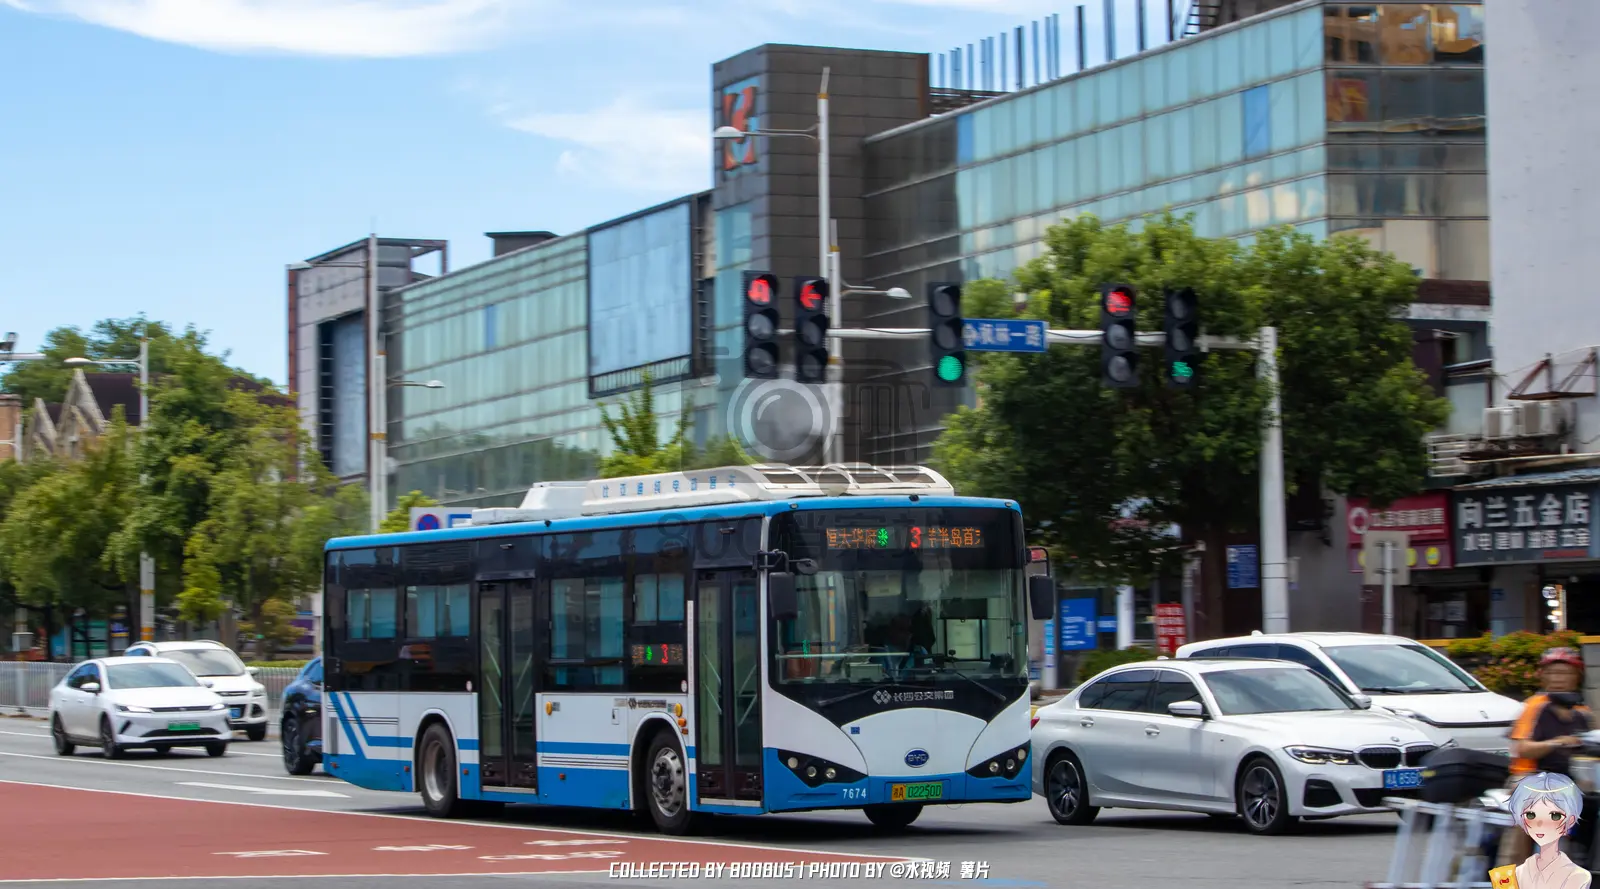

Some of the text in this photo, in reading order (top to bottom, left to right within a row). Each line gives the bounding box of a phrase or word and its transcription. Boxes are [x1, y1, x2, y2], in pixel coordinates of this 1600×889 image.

[910, 527, 922, 548] 3
[893, 690, 955, 702] 长沙公交集团
[842, 788, 867, 799] 7674
